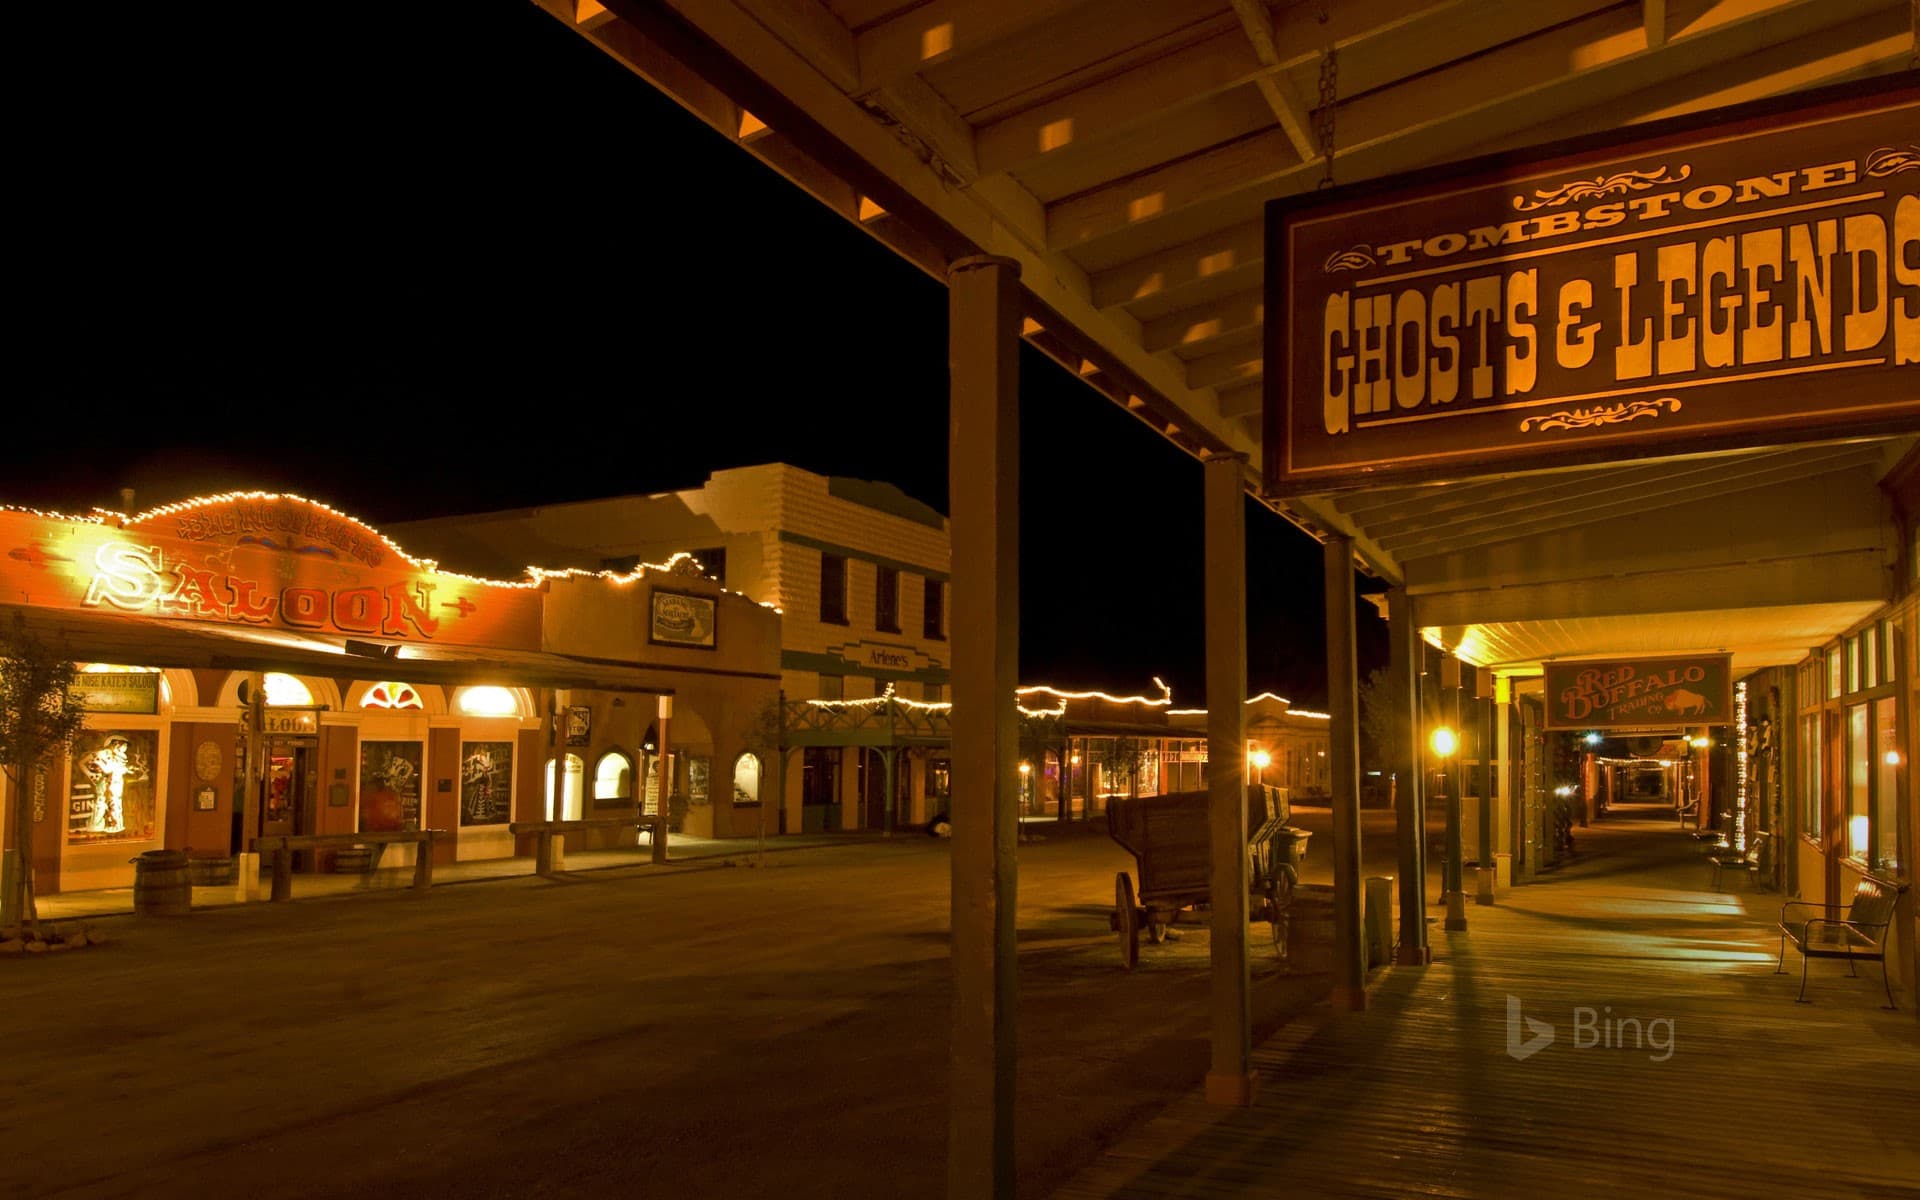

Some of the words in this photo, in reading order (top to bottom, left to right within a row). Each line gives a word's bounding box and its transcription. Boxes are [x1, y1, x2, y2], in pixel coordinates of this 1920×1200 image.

[1377, 159, 1856, 266] TOMBSTONE
[1324, 268, 1537, 435] GHOSTS
[1556, 279, 1601, 369] &
[1615, 193, 1920, 381] LEGENDS
[81, 540, 440, 639] SALOON
[1561, 666, 1705, 720] BUFFALO
[1577, 665, 1636, 695] RED
[72, 799, 96, 812] GIN
